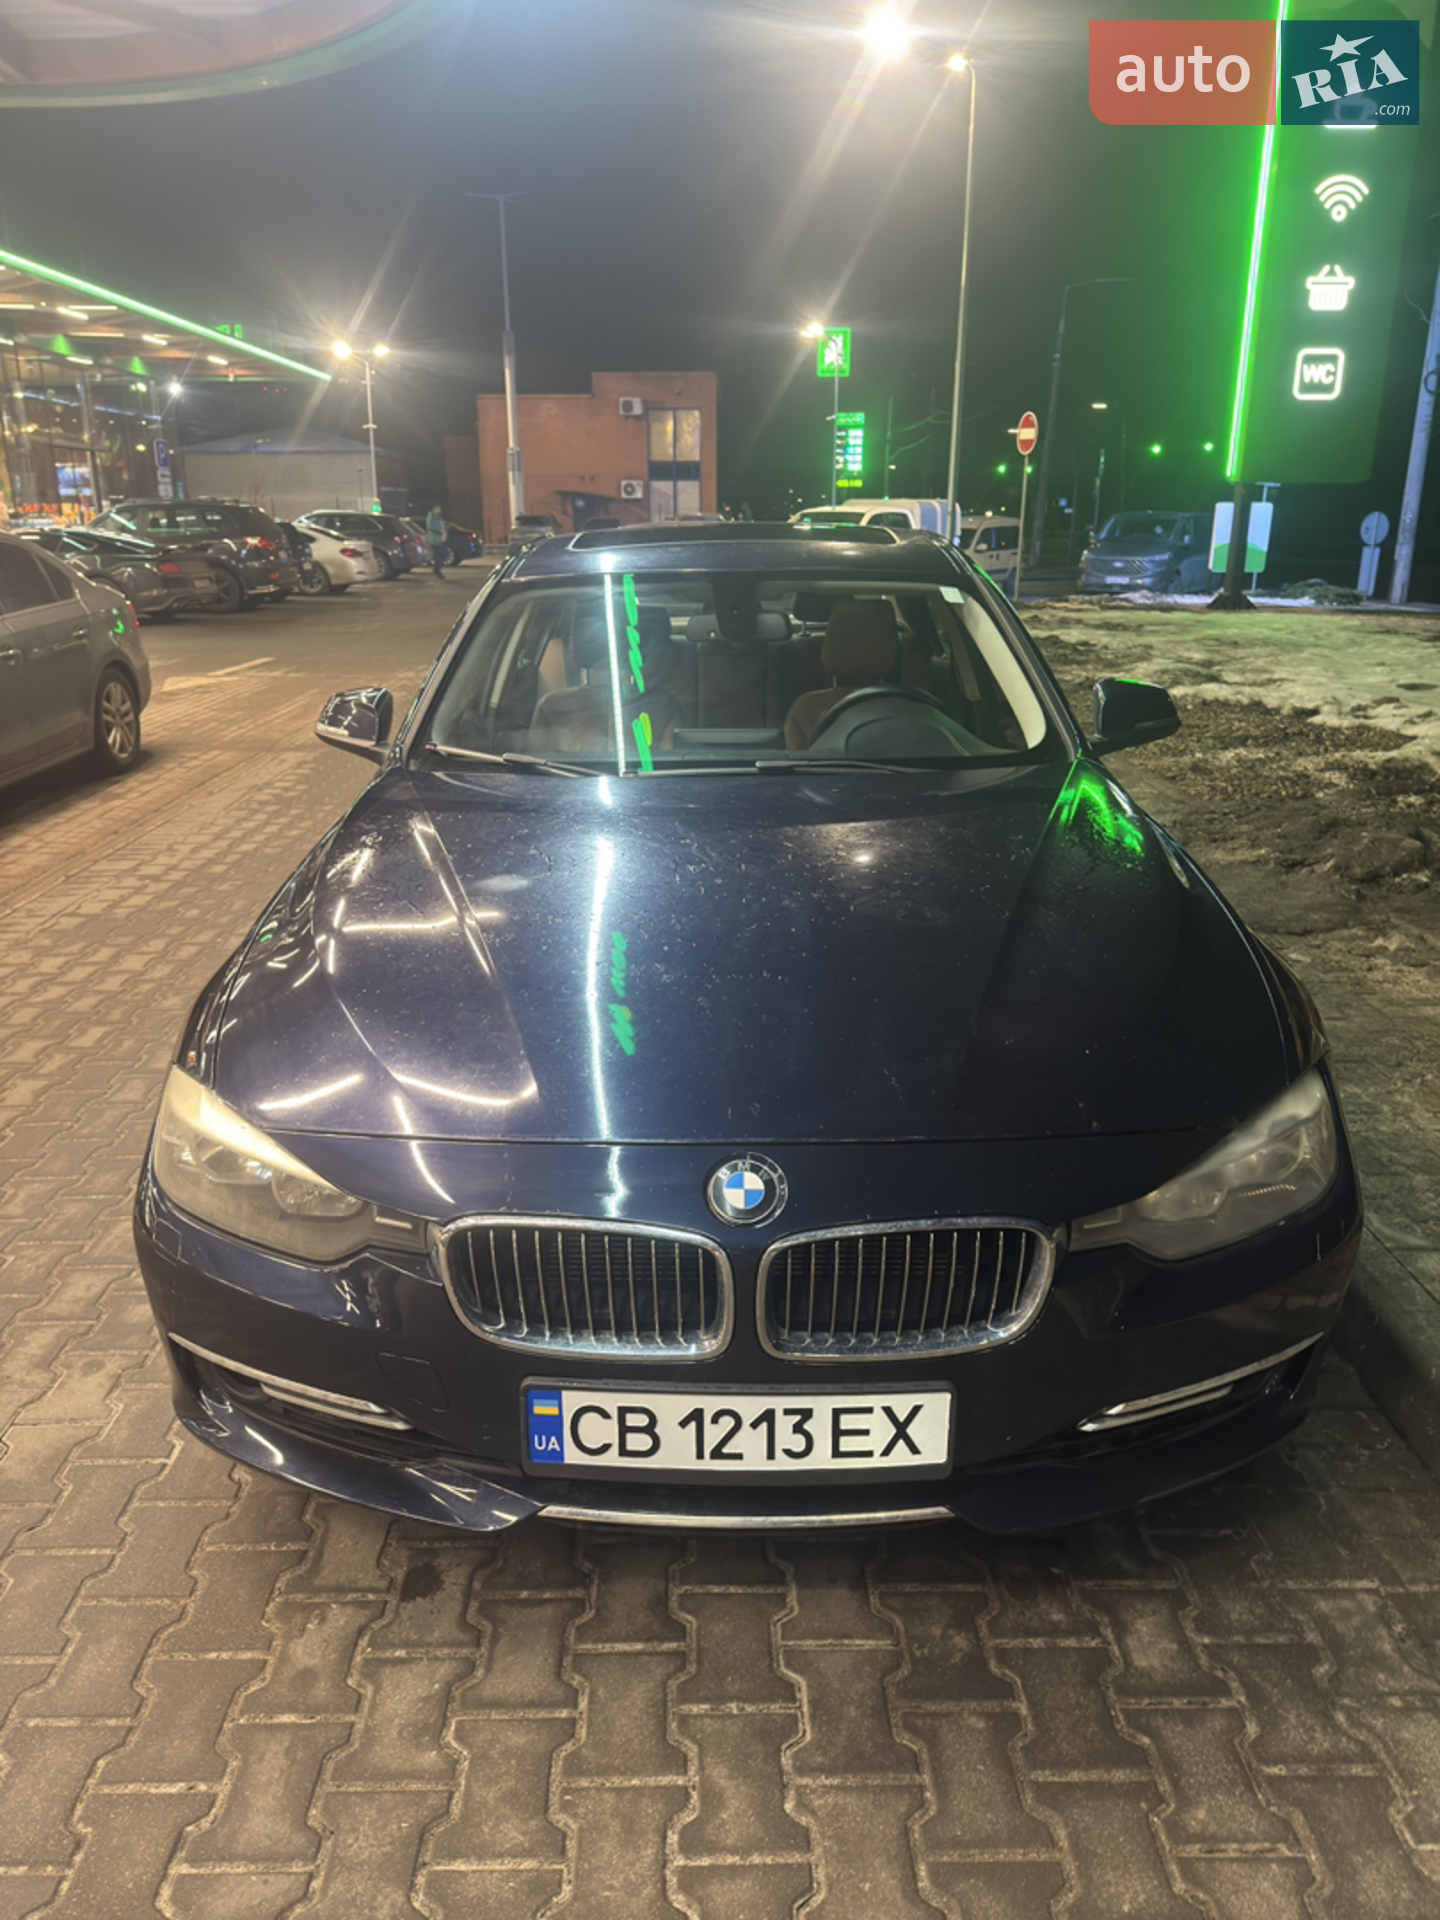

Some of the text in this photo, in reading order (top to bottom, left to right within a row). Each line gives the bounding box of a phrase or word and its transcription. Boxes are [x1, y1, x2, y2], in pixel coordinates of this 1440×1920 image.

[1303, 364, 1335, 384] WC
[718, 1160, 771, 1181] BMW
[570, 1404, 924, 1460] CB 1213 EX
[534, 1434, 560, 1451] UA
